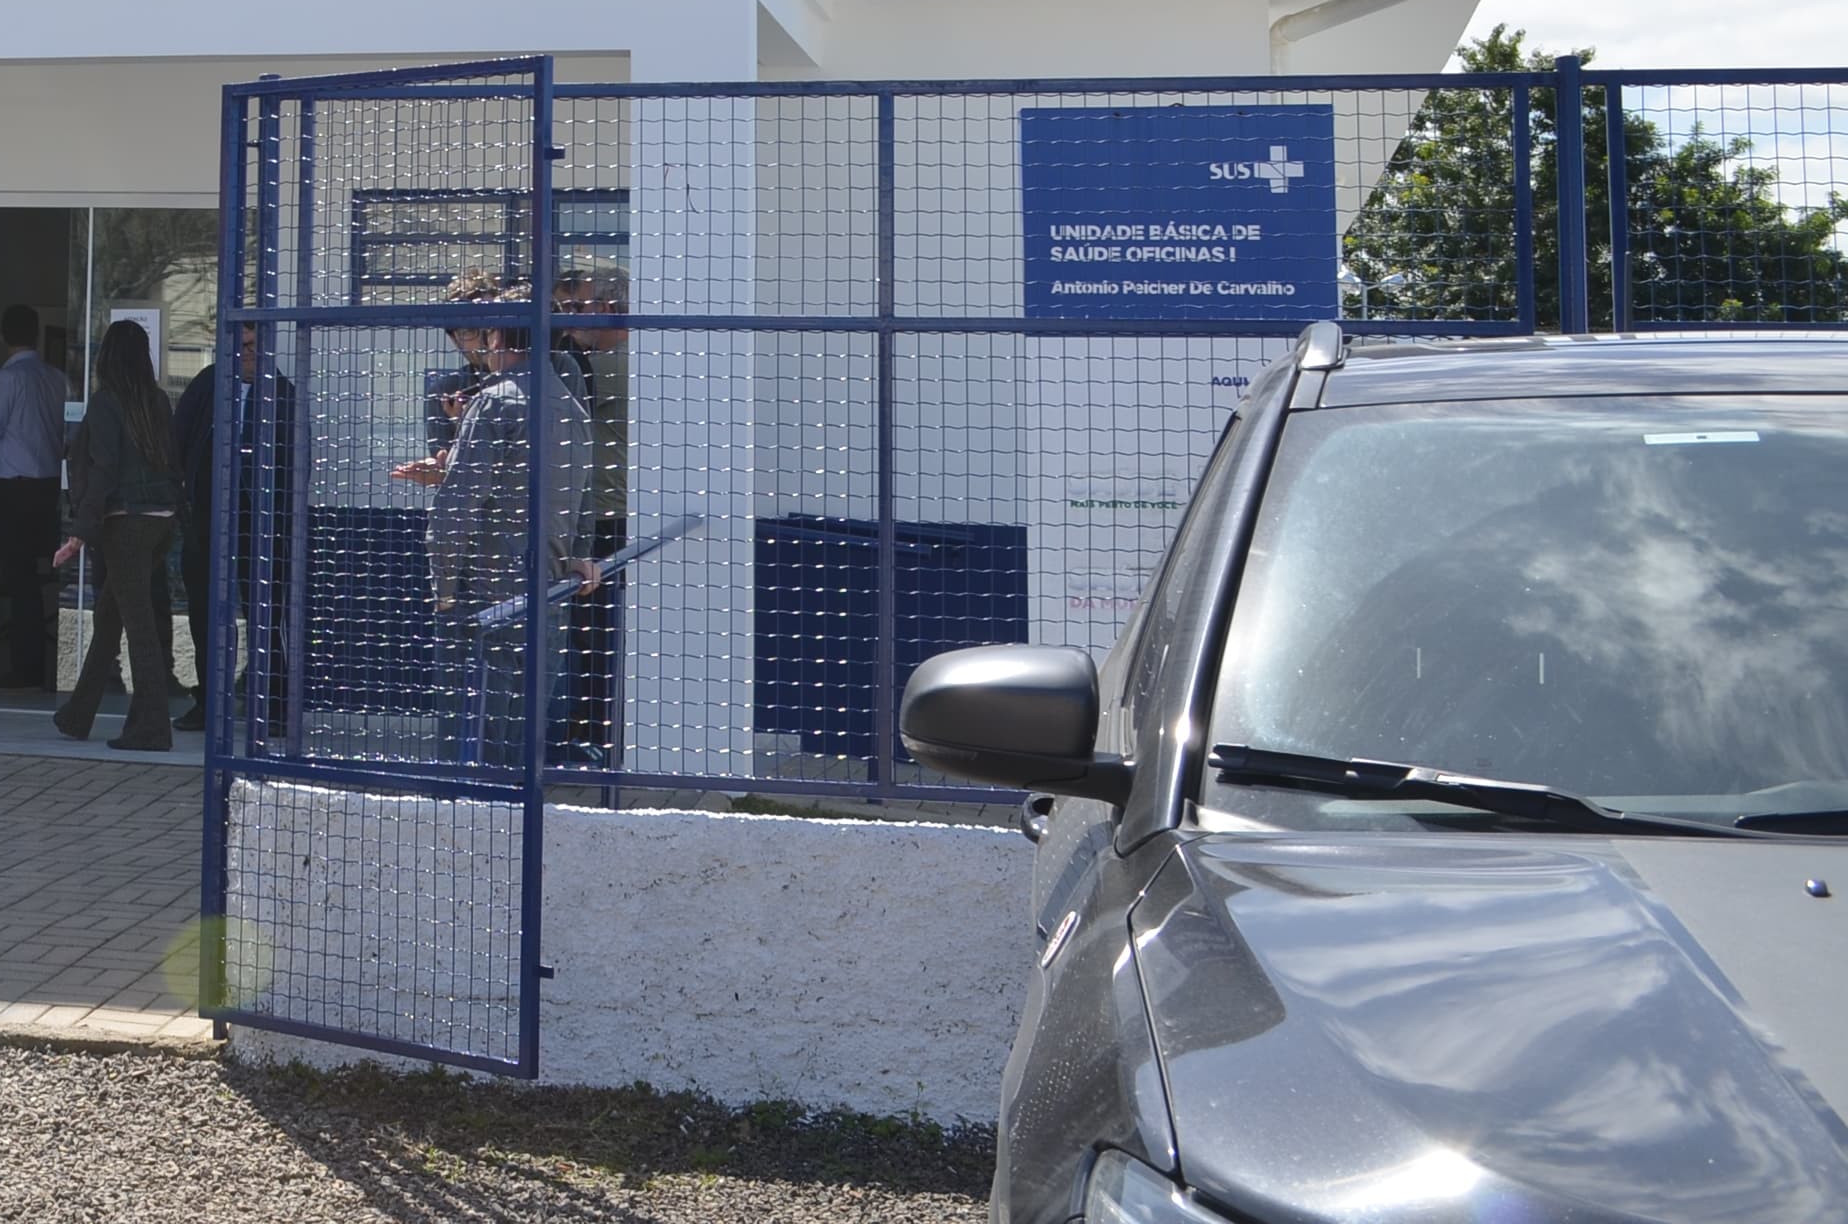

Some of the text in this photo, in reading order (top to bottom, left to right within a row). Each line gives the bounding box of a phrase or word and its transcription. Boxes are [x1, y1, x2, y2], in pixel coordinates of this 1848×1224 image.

[1209, 162, 1251, 180] SUS
[1050, 221, 1261, 241] UNIDADE BÁSICA DE
[1050, 242, 1122, 262] SAÚDE
[1126, 246, 1225, 262] OFICINAS
[1051, 280, 1296, 296] Antonio Peicher De Carvalho
